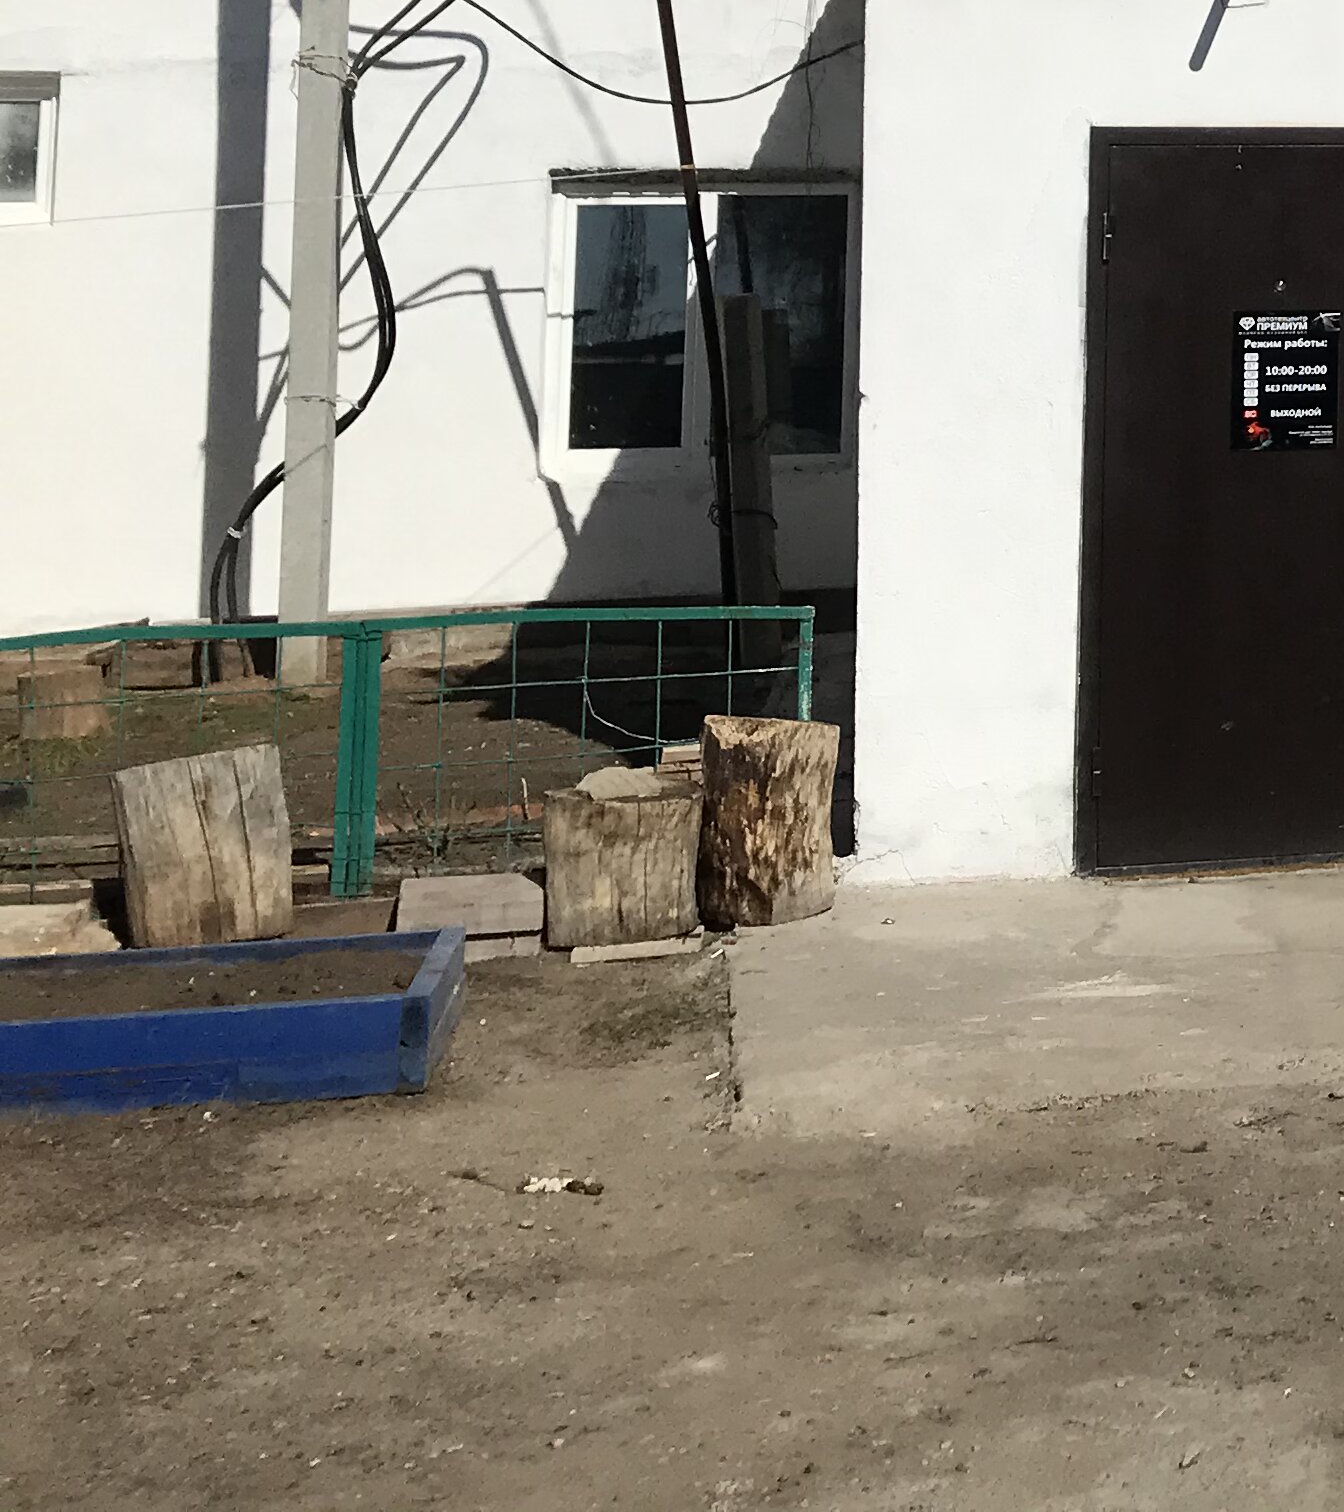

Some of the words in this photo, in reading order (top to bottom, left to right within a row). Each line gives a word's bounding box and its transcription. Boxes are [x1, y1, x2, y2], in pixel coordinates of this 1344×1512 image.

[1257, 322, 1308, 331] ПРЕМИУМ
[1244, 339, 1282, 348] Режим
[1284, 338, 1328, 350] работы:
[1265, 365, 1327, 376] 10:00-20:00
[1265, 384, 1280, 392] БЕЗ
[1282, 383, 1327, 392] ПЕРЕРЫВА
[1270, 407, 1321, 418] ВЫХОДНОЙ
